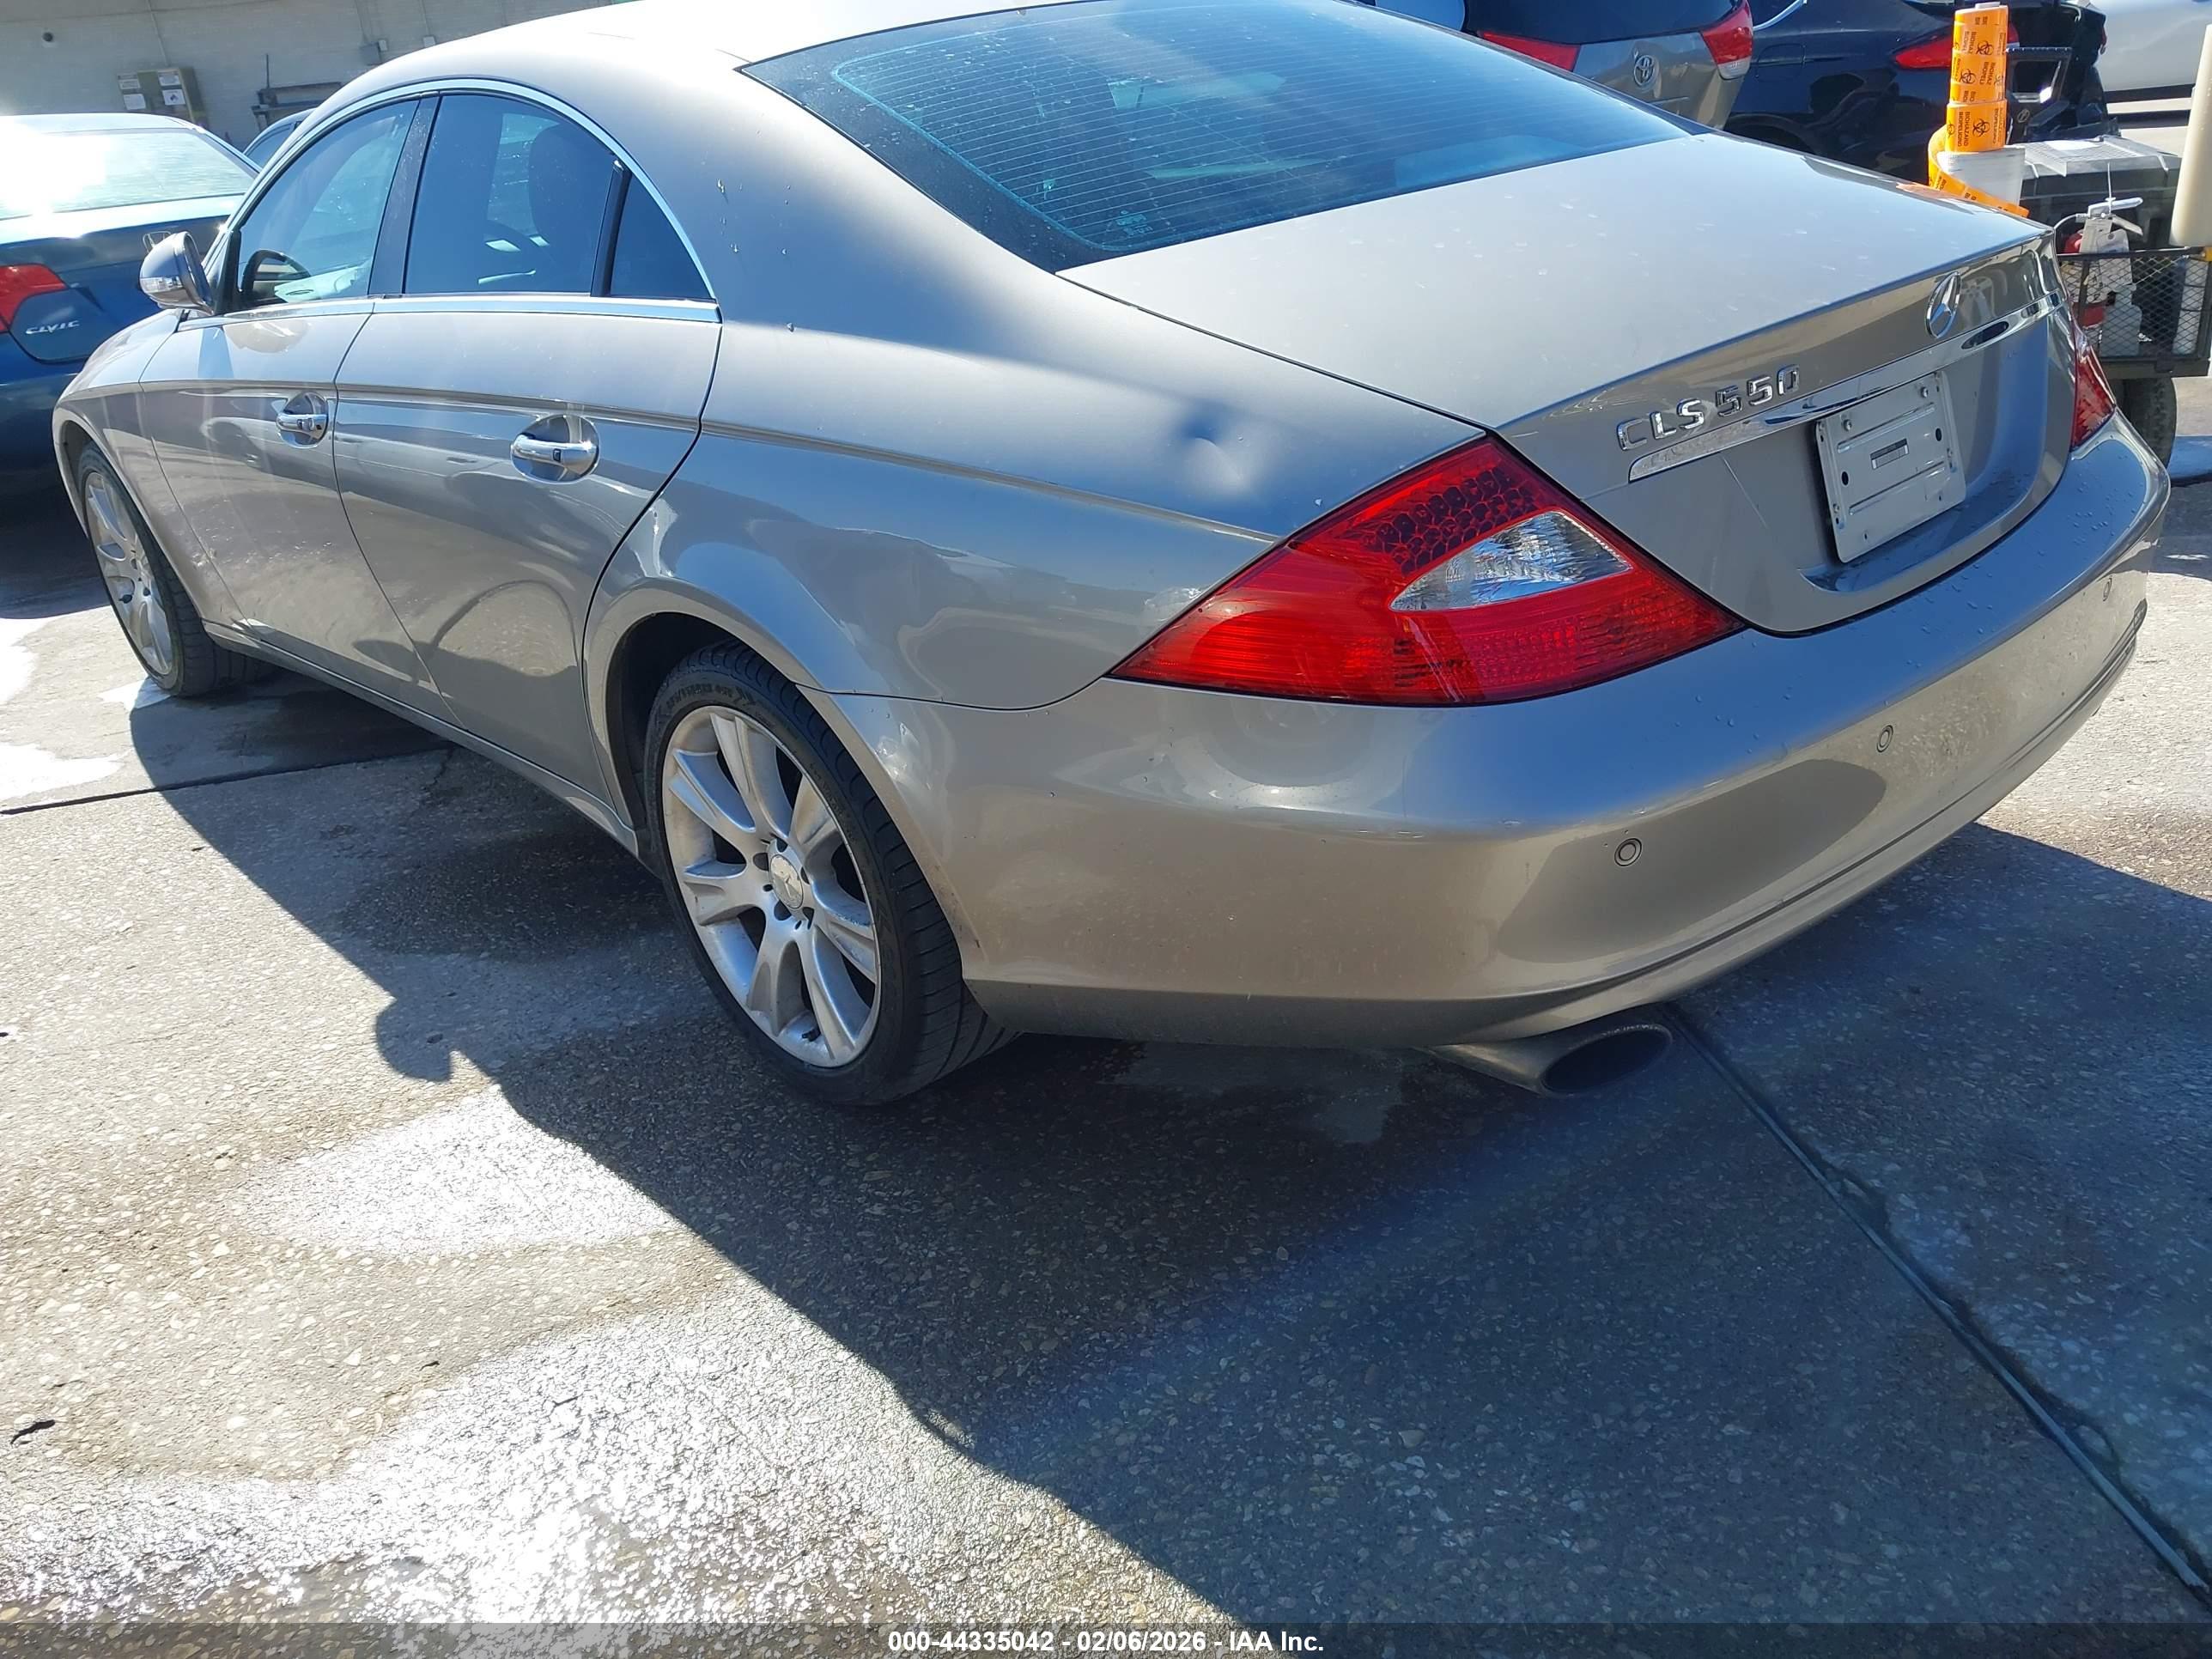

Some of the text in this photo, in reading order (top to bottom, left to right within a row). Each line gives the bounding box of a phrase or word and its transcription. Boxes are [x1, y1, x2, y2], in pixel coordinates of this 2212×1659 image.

[25, 320, 80, 335] CIVIC
[1616, 363, 1801, 452] CLS 550
